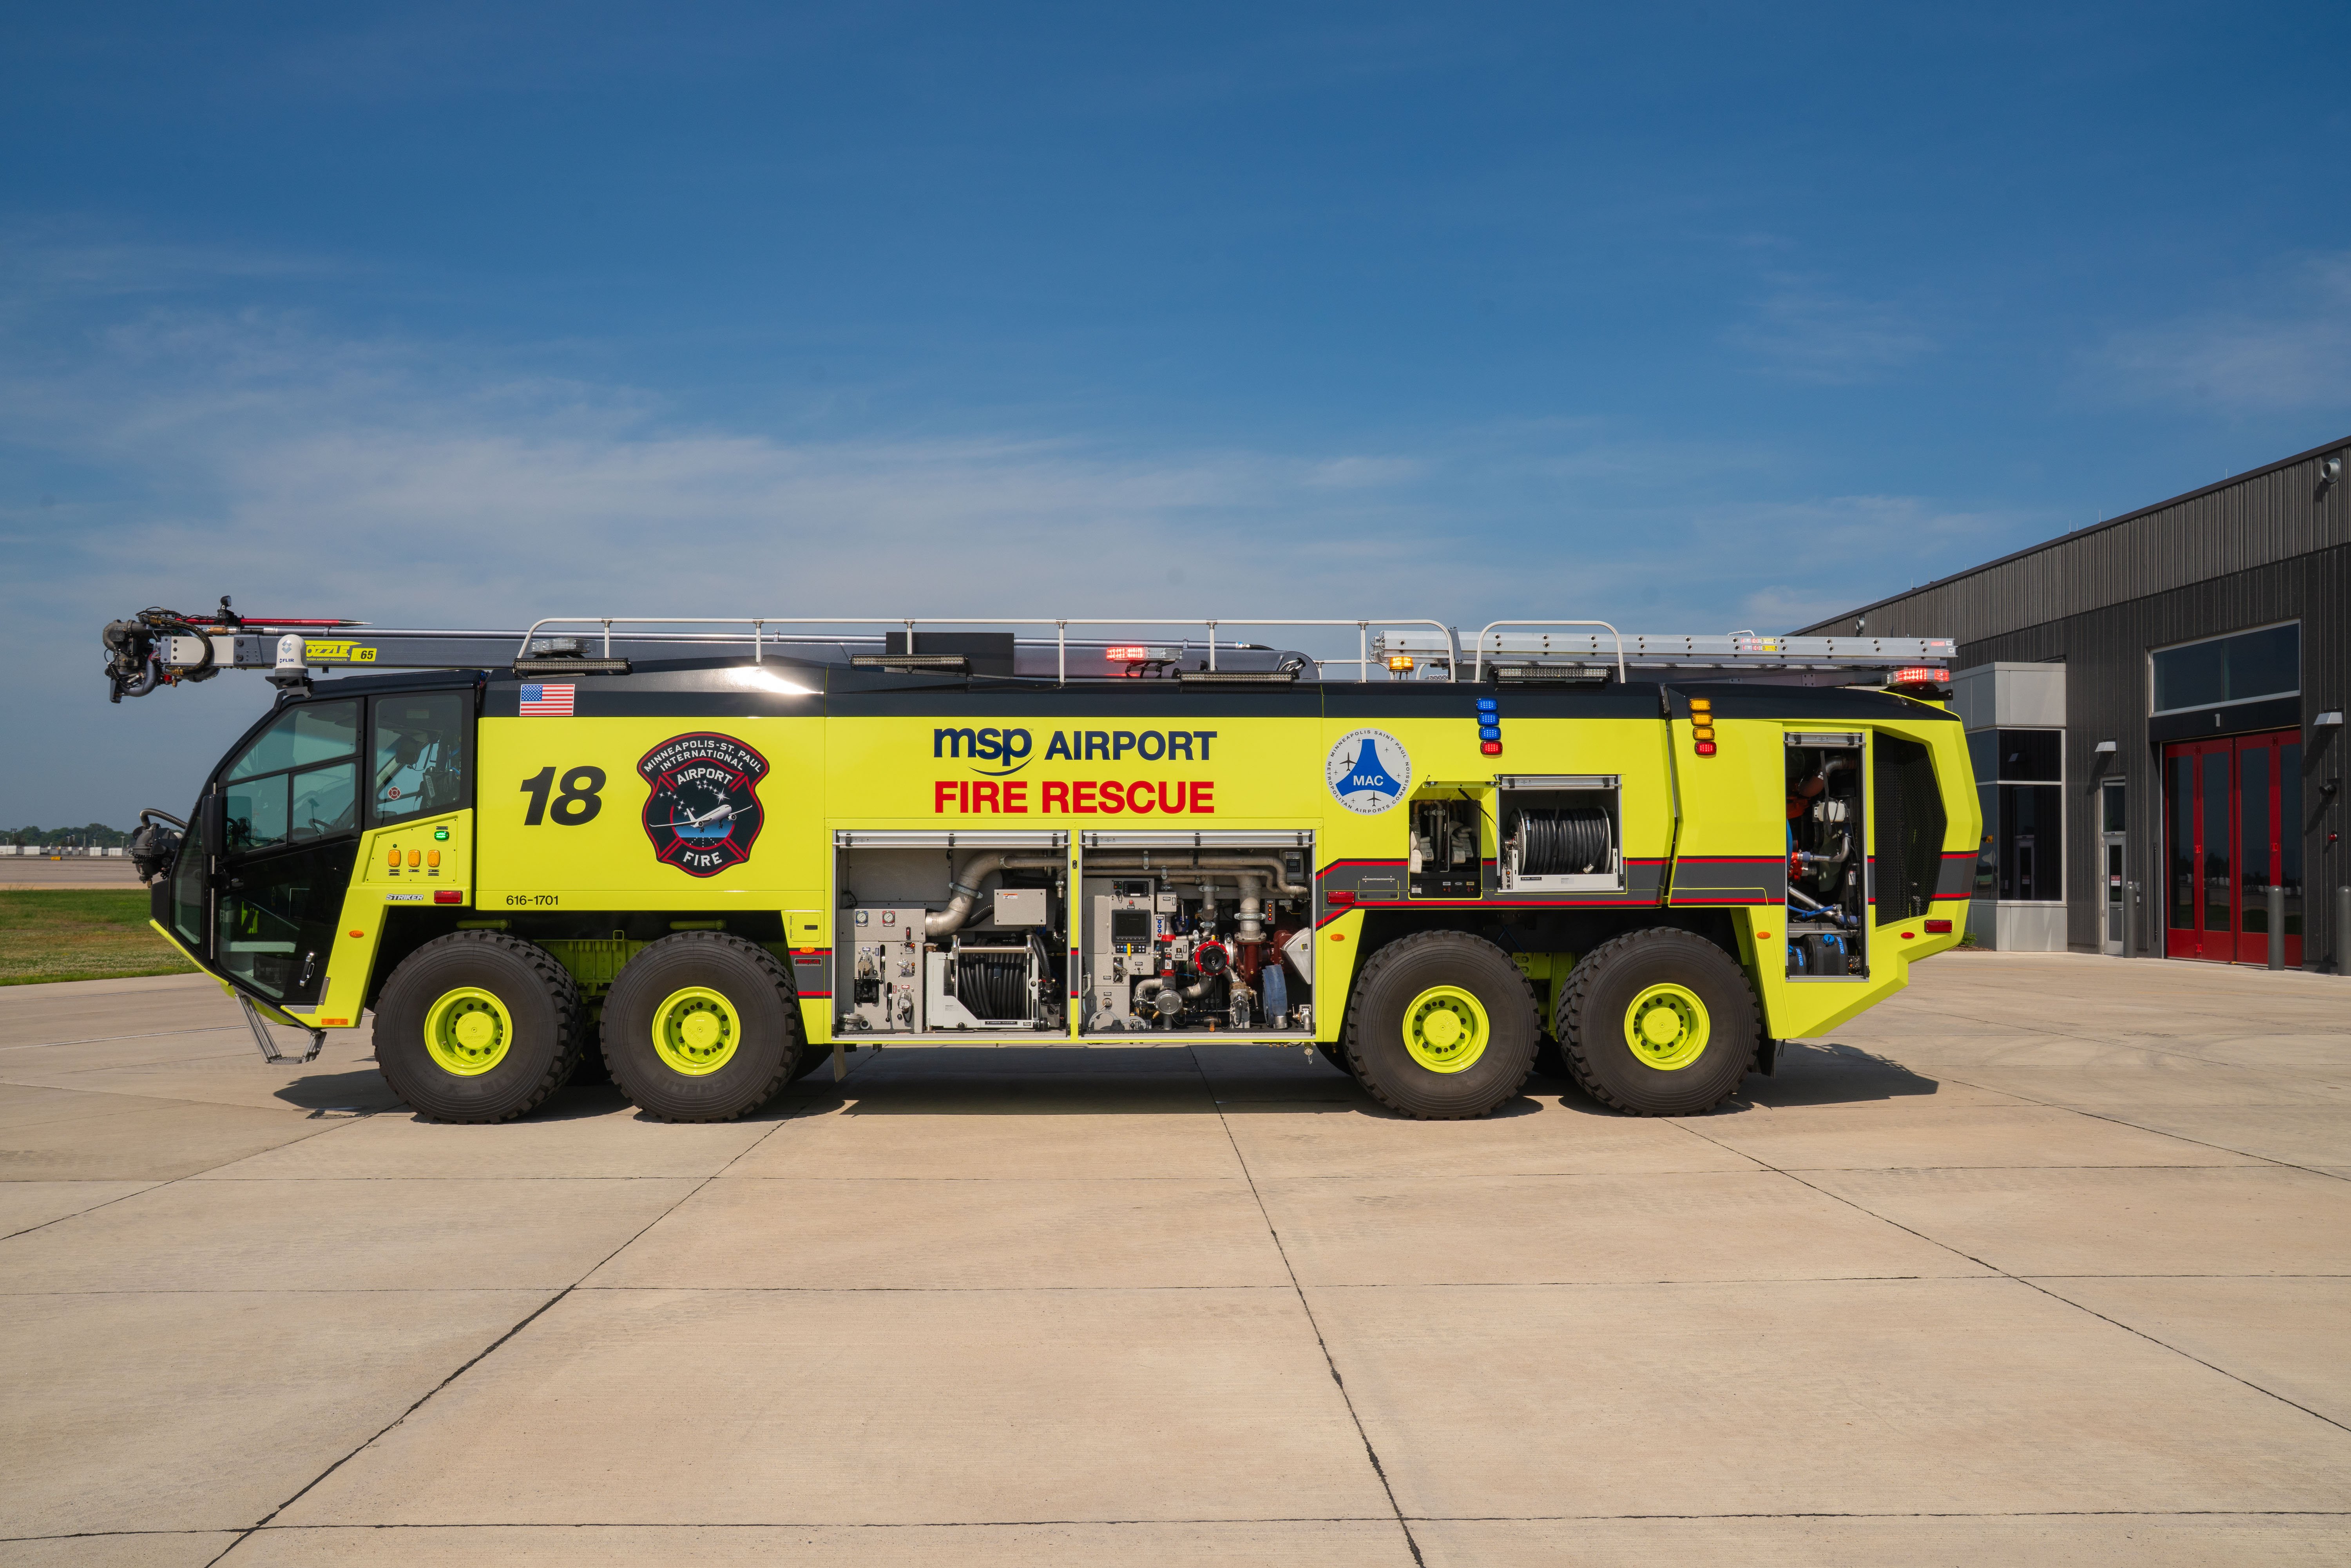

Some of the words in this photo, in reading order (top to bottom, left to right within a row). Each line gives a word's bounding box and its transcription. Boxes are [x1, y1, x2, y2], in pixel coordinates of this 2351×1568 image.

[306, 645, 350, 657] OZZLE
[2215, 713, 2220, 726] 1
[933, 728, 1032, 766] msp
[1044, 730, 1217, 760] AIRPORT
[1331, 730, 1371, 757] MINNEAPOLIS
[1374, 731, 1394, 741] SAINT
[1395, 742, 1406, 759] PAUL
[660, 750, 743, 771] INTERNATIONAL
[738, 750, 761, 772] PAUL
[677, 768, 733, 785] AIRPORT
[1327, 761, 1352, 809] METROPOLITAN
[1355, 804, 1390, 813] AIRPORTS
[1392, 762, 1410, 804] COMMISSION
[1353, 775, 1384, 786] MAC
[520, 766, 606, 826] 18
[935, 781, 1027, 813] FIRE
[1042, 780, 1214, 814] RESCUE
[683, 851, 722, 866] FIRE
[506, 895, 558, 905] 616-1701
